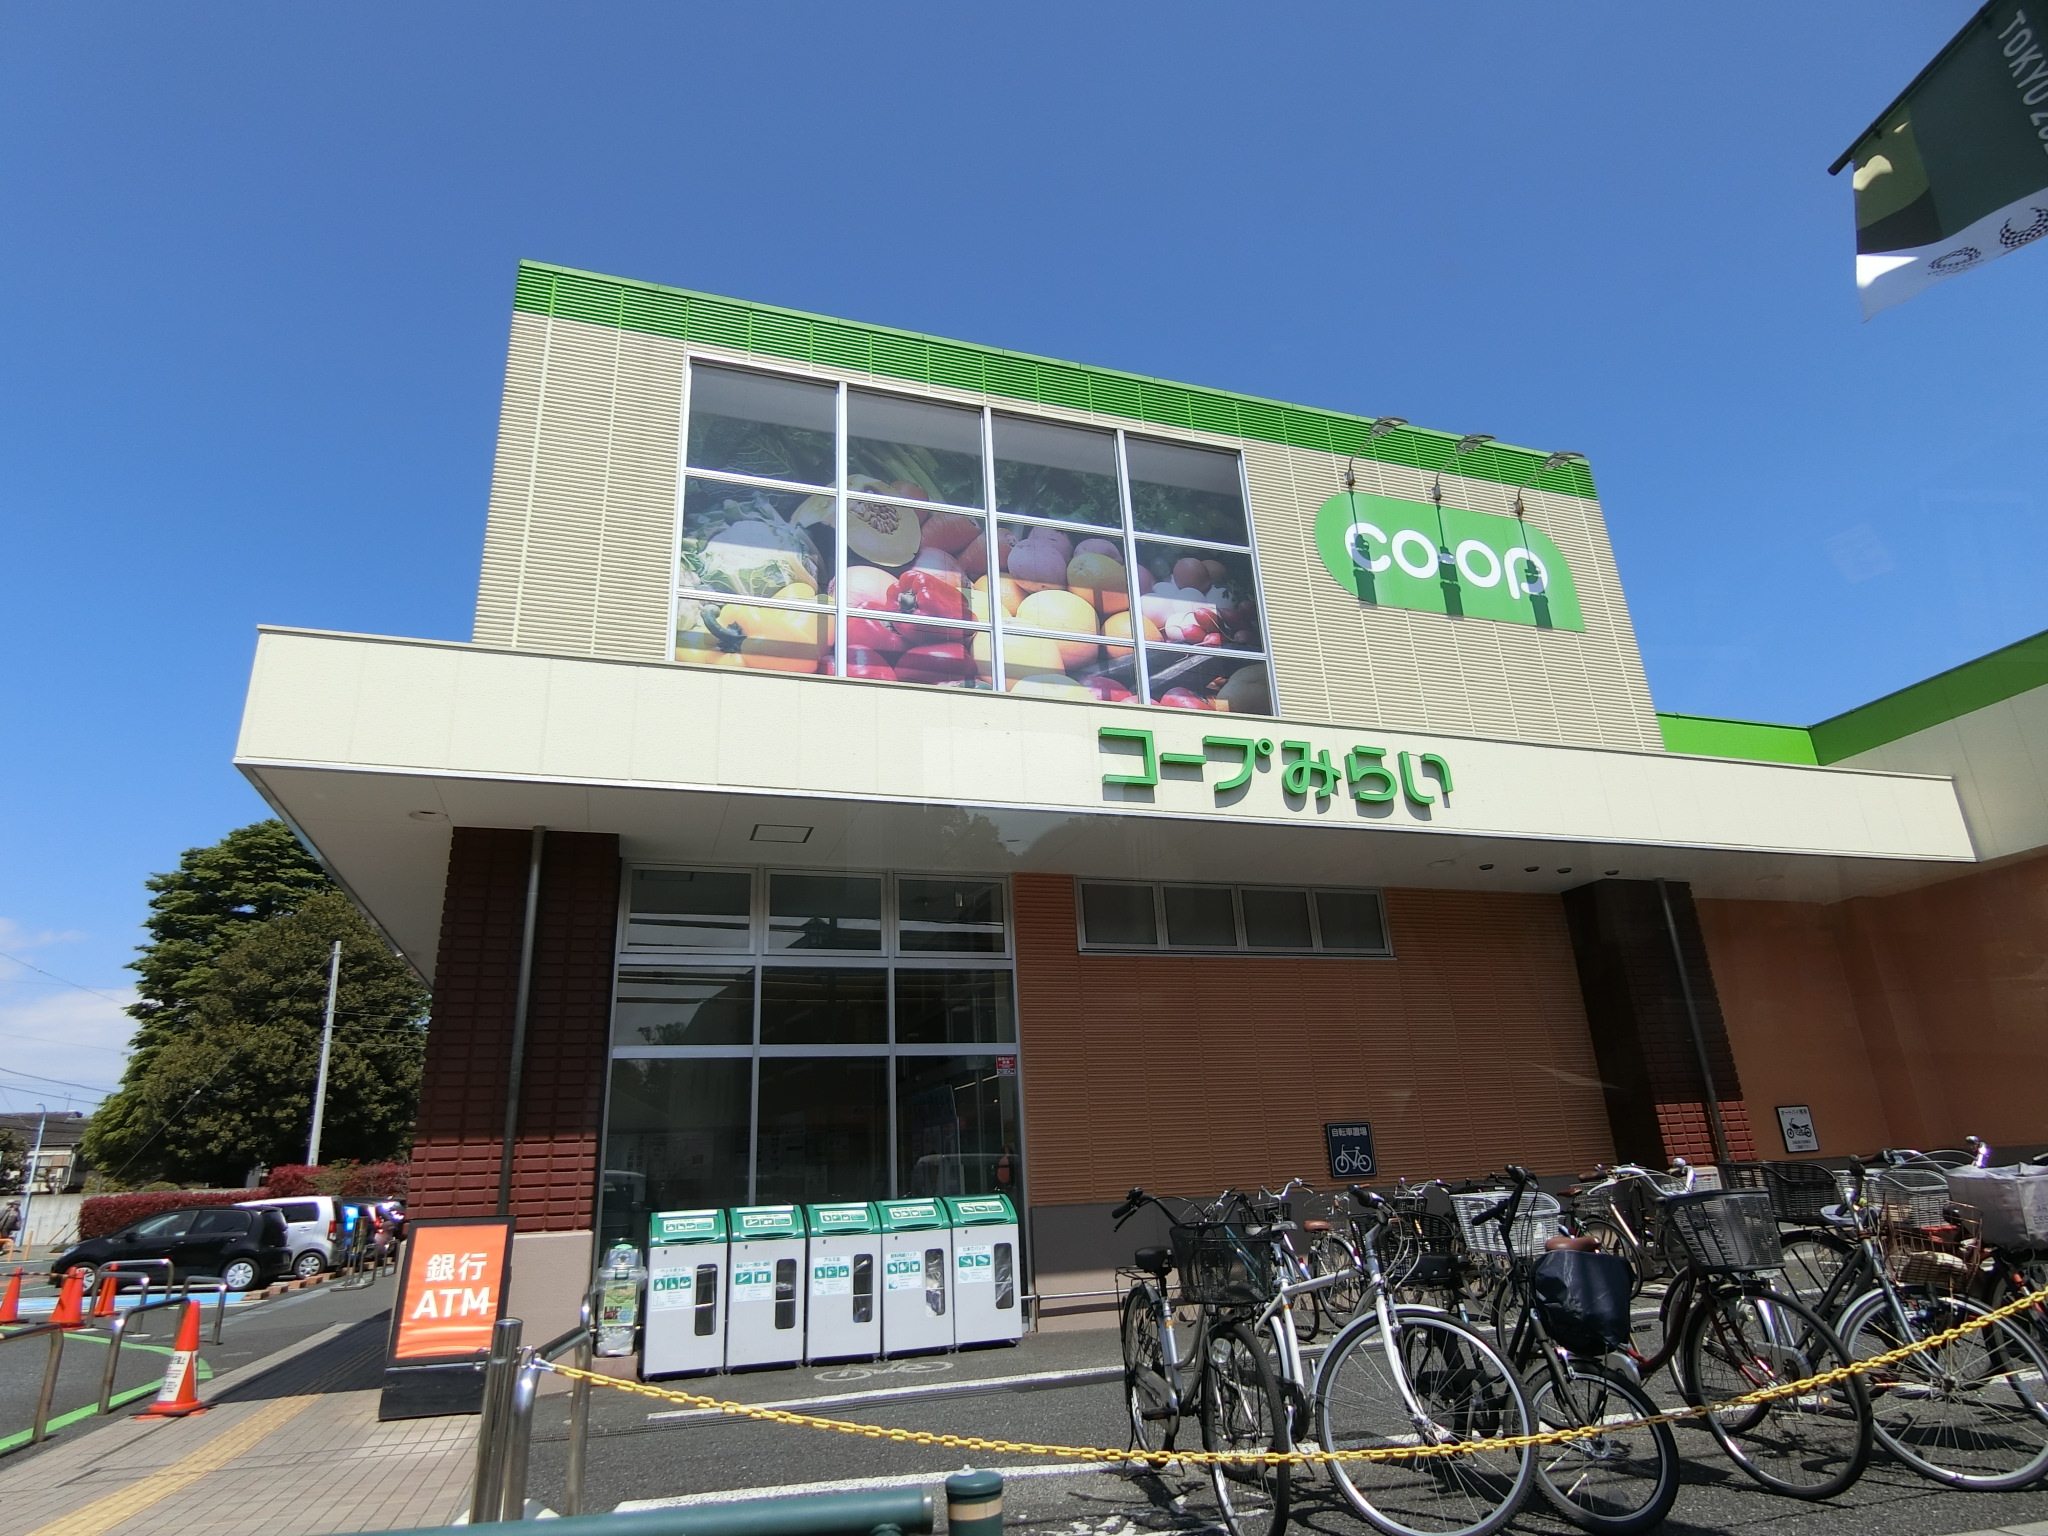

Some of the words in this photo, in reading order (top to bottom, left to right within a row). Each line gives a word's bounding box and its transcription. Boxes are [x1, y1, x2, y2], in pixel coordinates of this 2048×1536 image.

[1998, 9, 2048, 106] TOKYO
[1098, 727, 1453, 805] コープみらい
[1331, 1127, 1367, 1137] 自転車置場
[425, 1252, 488, 1283] 銀行
[412, 1286, 490, 1319] ATM
